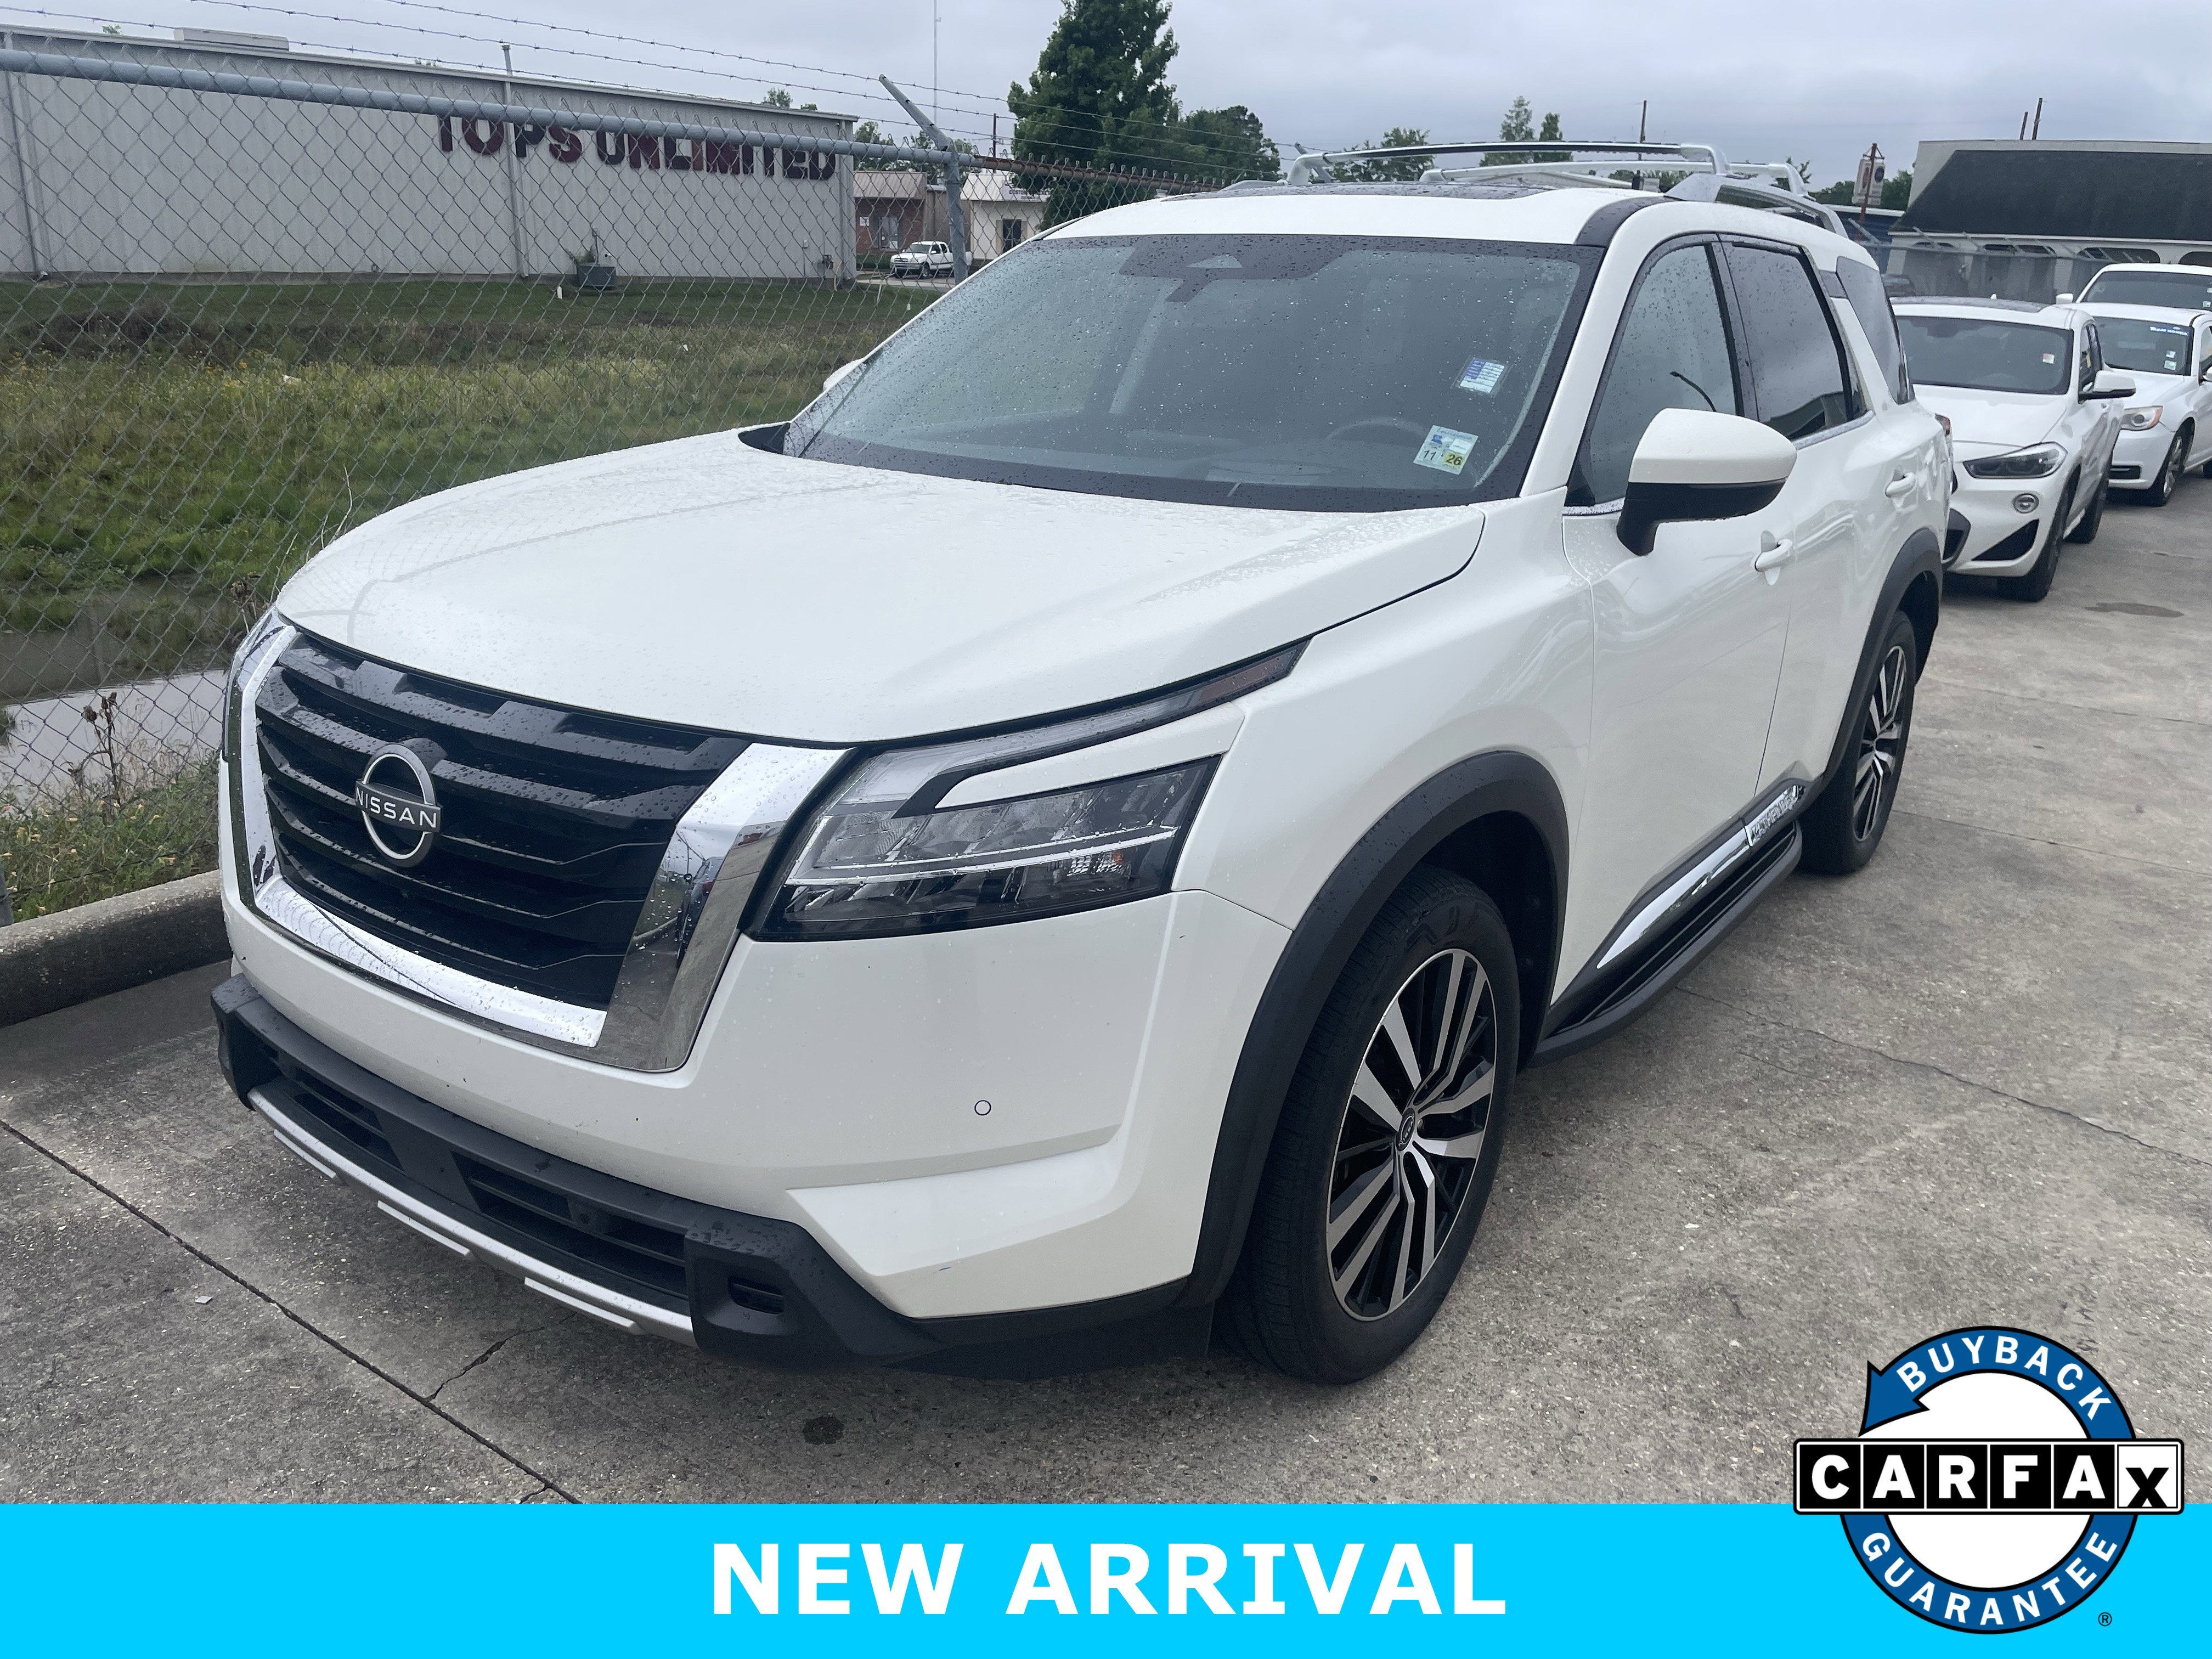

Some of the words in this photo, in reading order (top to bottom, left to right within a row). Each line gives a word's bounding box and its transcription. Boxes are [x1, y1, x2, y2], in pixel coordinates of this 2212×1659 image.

[1424, 450, 1436, 461] 11
[1446, 454, 1463, 466] 26
[357, 787, 437, 828] NISSAN
